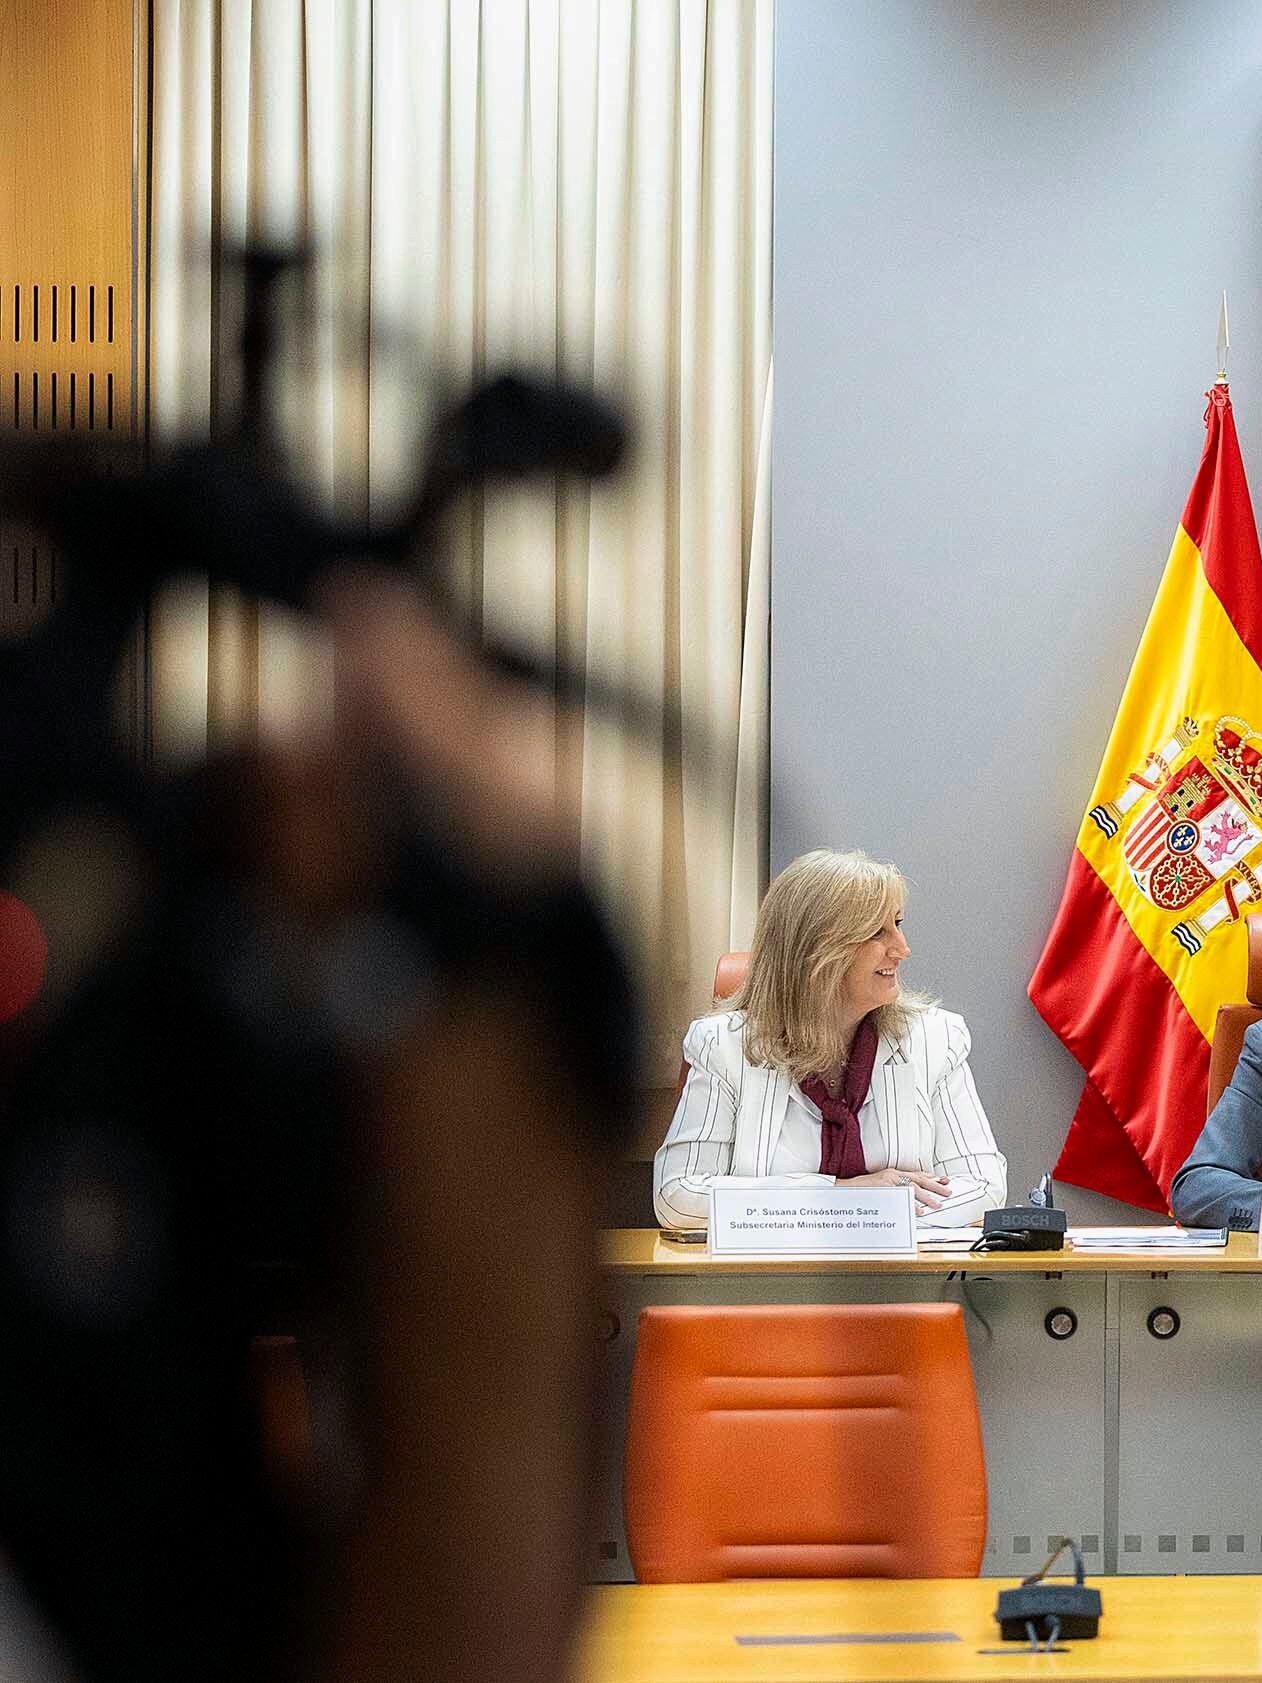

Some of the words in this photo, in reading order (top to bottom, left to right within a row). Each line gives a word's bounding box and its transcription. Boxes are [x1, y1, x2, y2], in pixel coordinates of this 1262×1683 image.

[1239, 862, 1261, 896] VLTRA
[762, 1208, 797, 1216] Susana
[799, 1207, 854, 1216] Crisóstomo
[856, 1208, 879, 1216] Sanz
[729, 1221, 795, 1229] Subsecretaria
[797, 1220, 844, 1229] Ministerio
[846, 1220, 860, 1228] del
[862, 1220, 896, 1228] Interior
[1001, 1215, 1049, 1226] BOSCH
